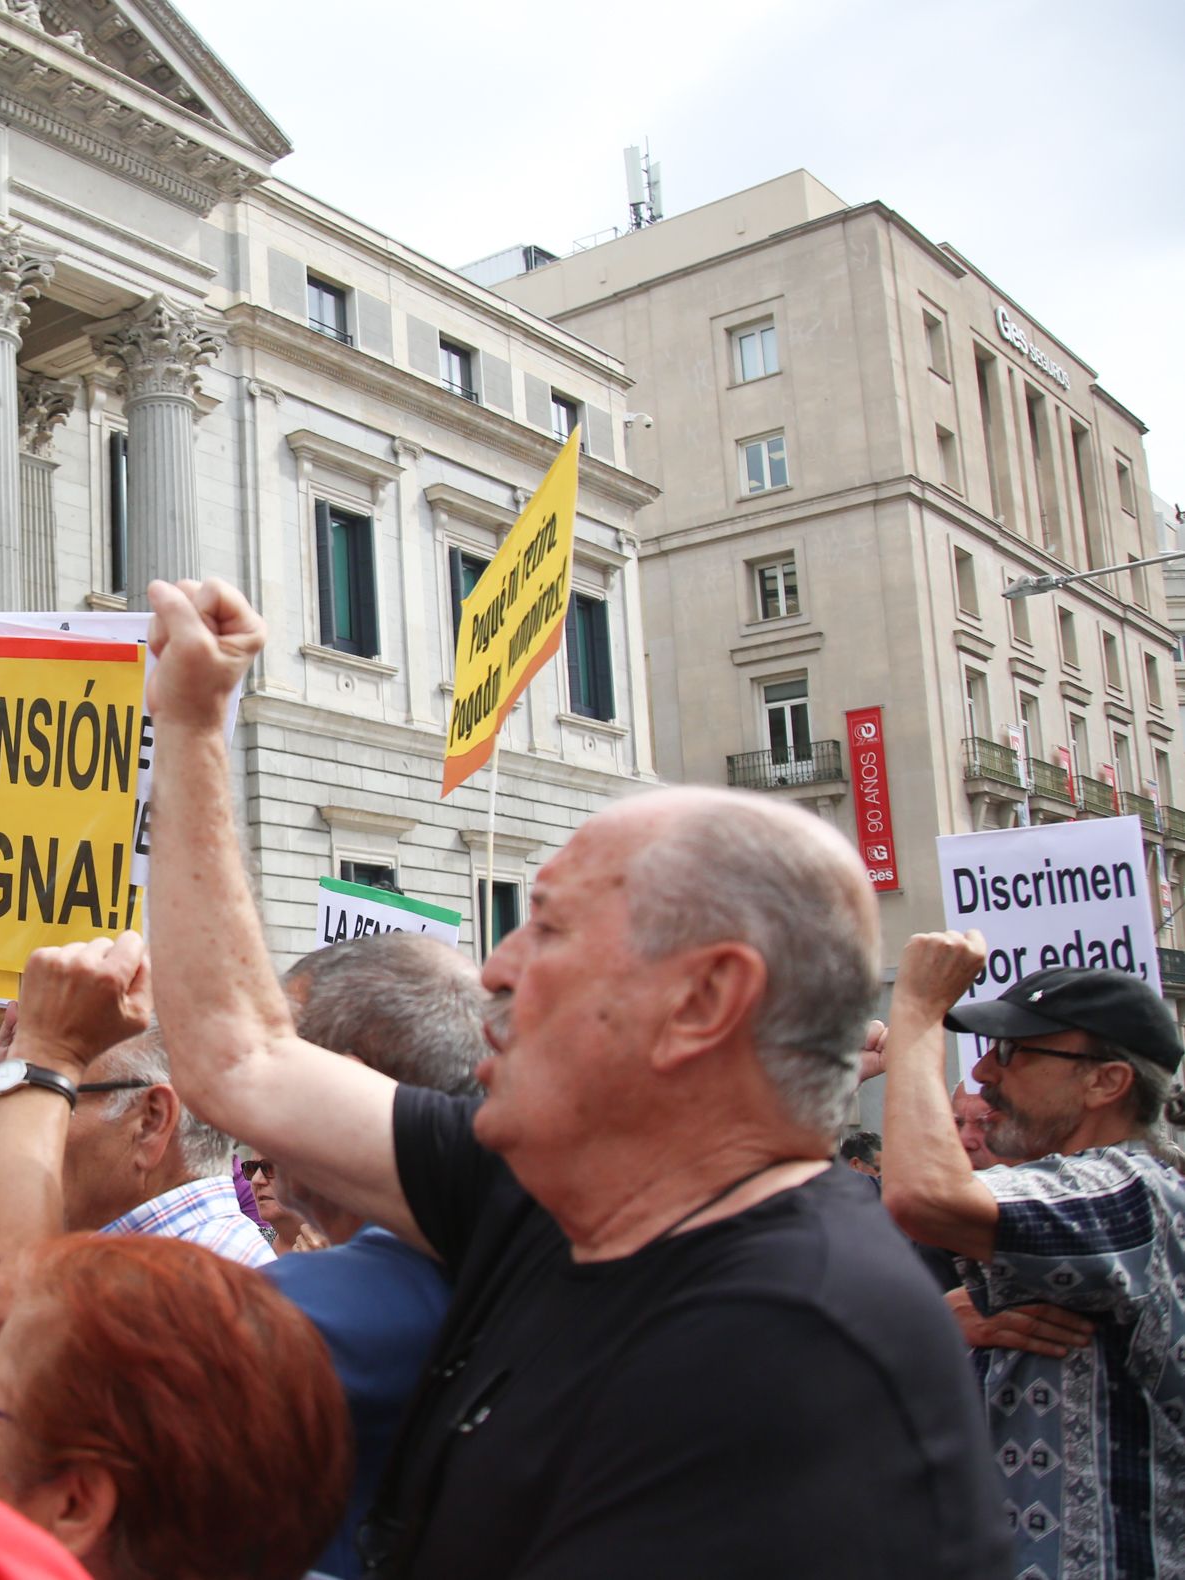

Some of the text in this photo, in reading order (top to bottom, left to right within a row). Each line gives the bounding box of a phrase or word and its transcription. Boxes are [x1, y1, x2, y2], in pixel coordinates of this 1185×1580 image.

[995, 305, 1071, 391] Ges SEGUROS
[860, 751, 881, 805] AÑOS
[866, 809, 884, 833] 90
[866, 868, 894, 883] Ges
[953, 858, 1136, 914] Discrimen
[324, 905, 347, 943] LA
